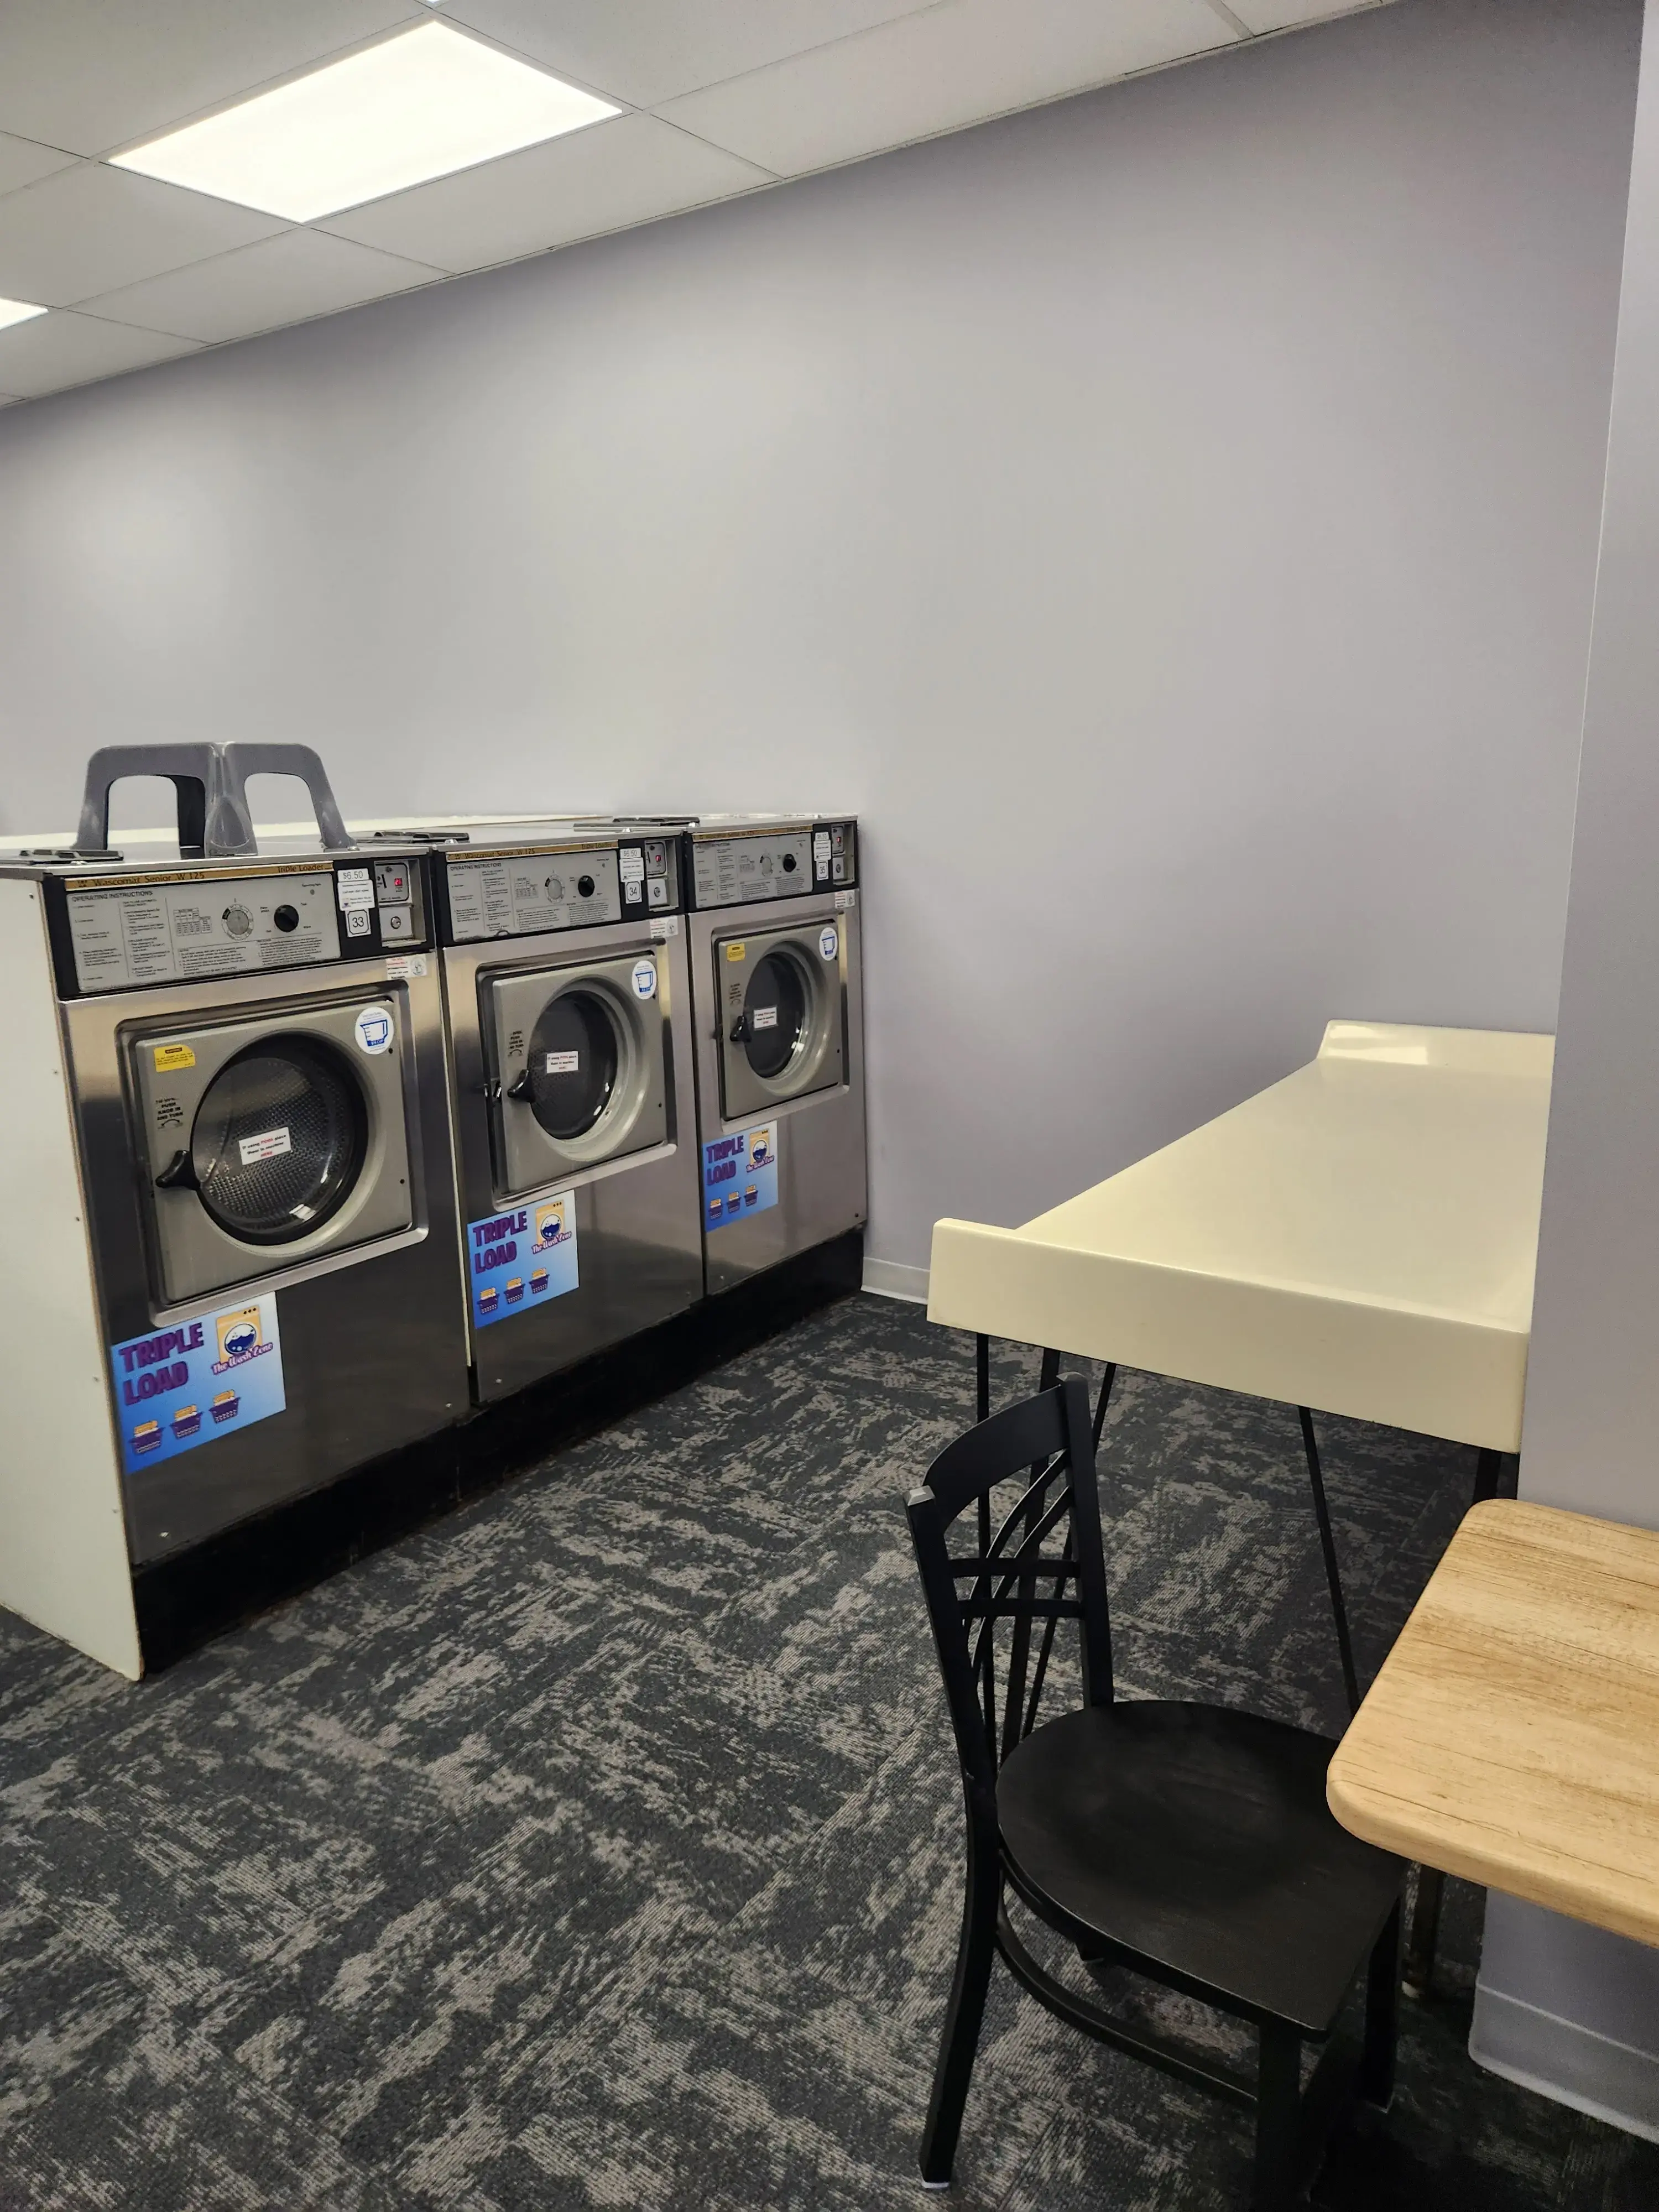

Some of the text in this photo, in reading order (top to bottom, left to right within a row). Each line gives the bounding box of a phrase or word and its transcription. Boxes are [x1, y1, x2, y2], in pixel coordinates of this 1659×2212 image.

[92, 877, 140, 886] Wascomat
[144, 874, 172, 883] Senior
[343, 870, 363, 880] $6.50
[71, 890, 153, 902] OPERATING INSTRUCTIONS
[629, 886, 637, 896] 34
[352, 916, 364, 928] 33
[706, 1135, 744, 1164] TRIPLE
[707, 1160, 737, 1186] LOAD
[473, 1211, 528, 1248] TRIPLE
[474, 1241, 518, 1274] LOAD
[531, 1244, 542, 1255] The
[542, 1237, 559, 1250] Wash
[118, 1322, 205, 1373] TRIPLE
[211, 1343, 274, 1375] The Wash Zone
[123, 1360, 189, 1406] LOAD
